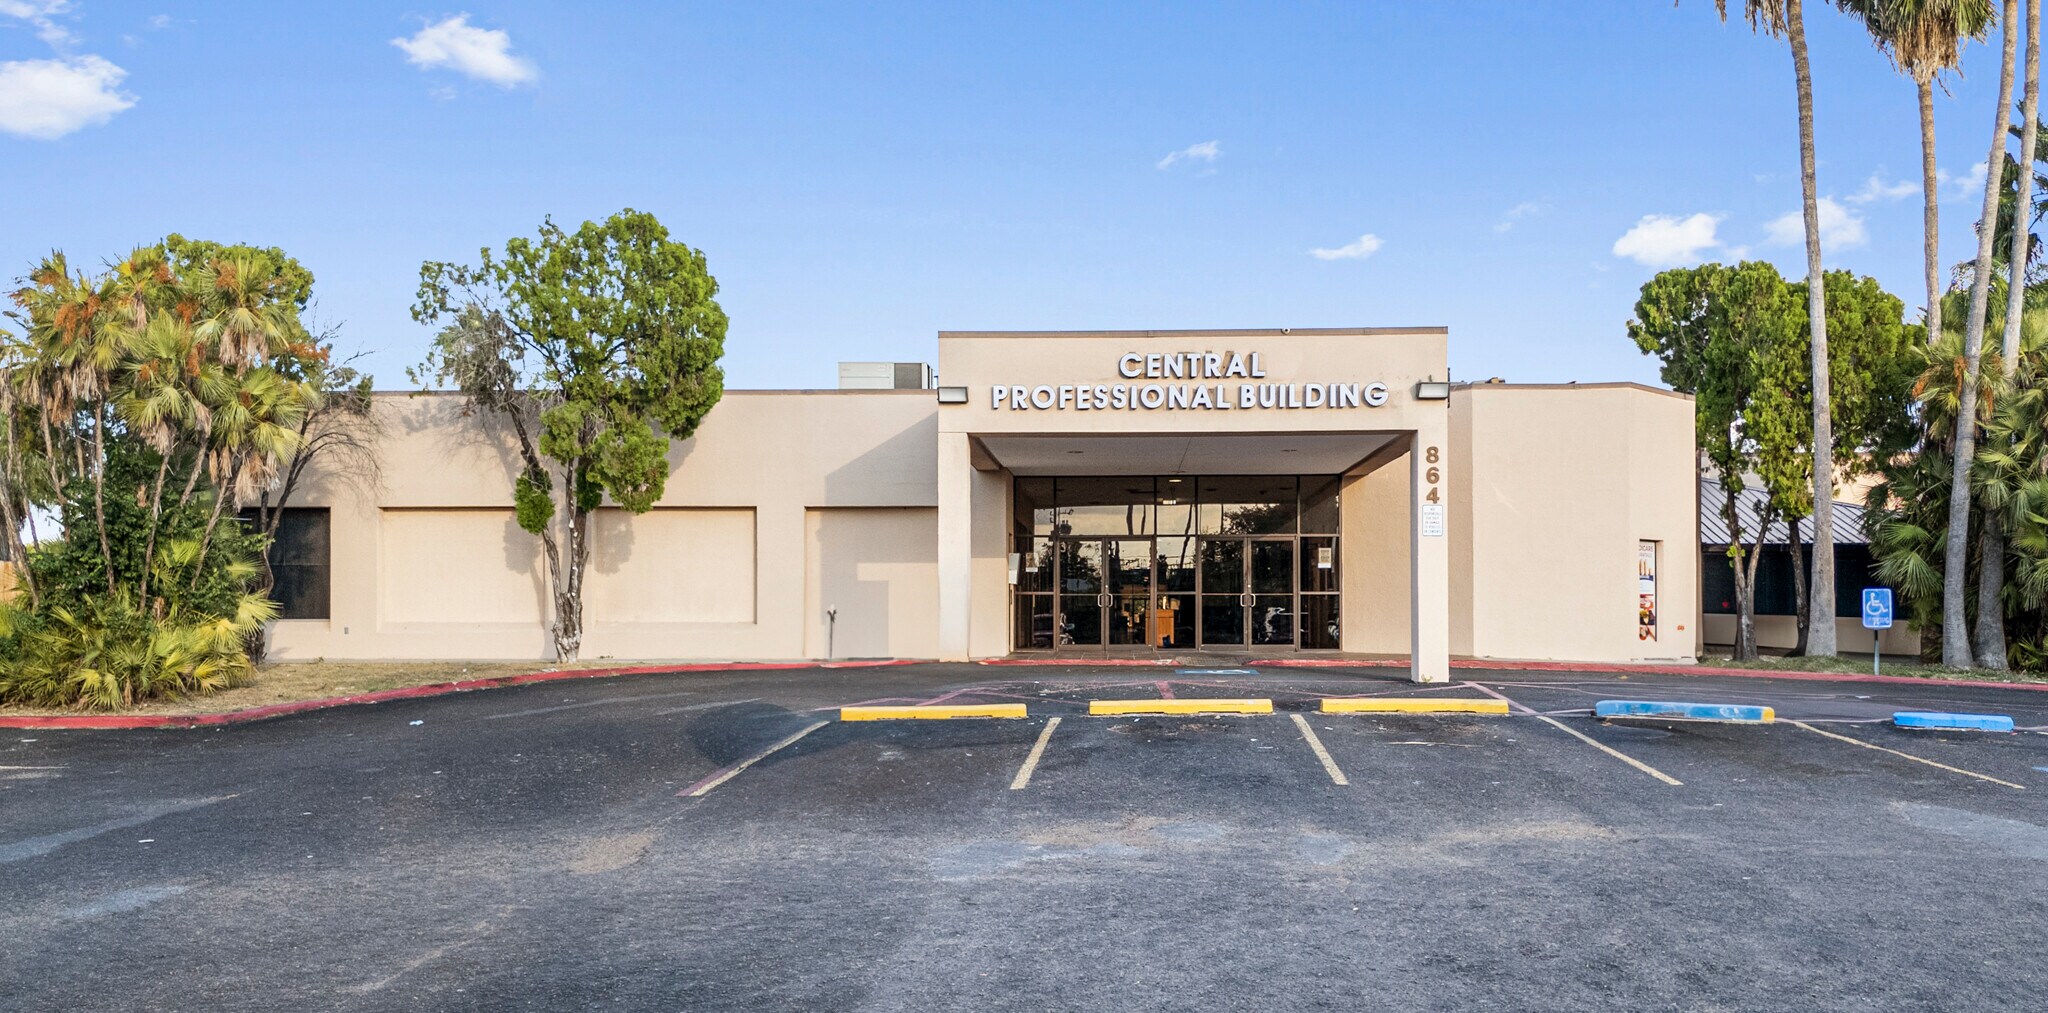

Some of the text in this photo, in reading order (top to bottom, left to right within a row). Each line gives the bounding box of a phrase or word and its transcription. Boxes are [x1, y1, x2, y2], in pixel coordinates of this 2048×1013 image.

[1118, 352, 1266, 378] CENTRAL
[991, 381, 1389, 410] PROFESSIONAL BUILDING
[1426, 446, 1440, 504] 864
